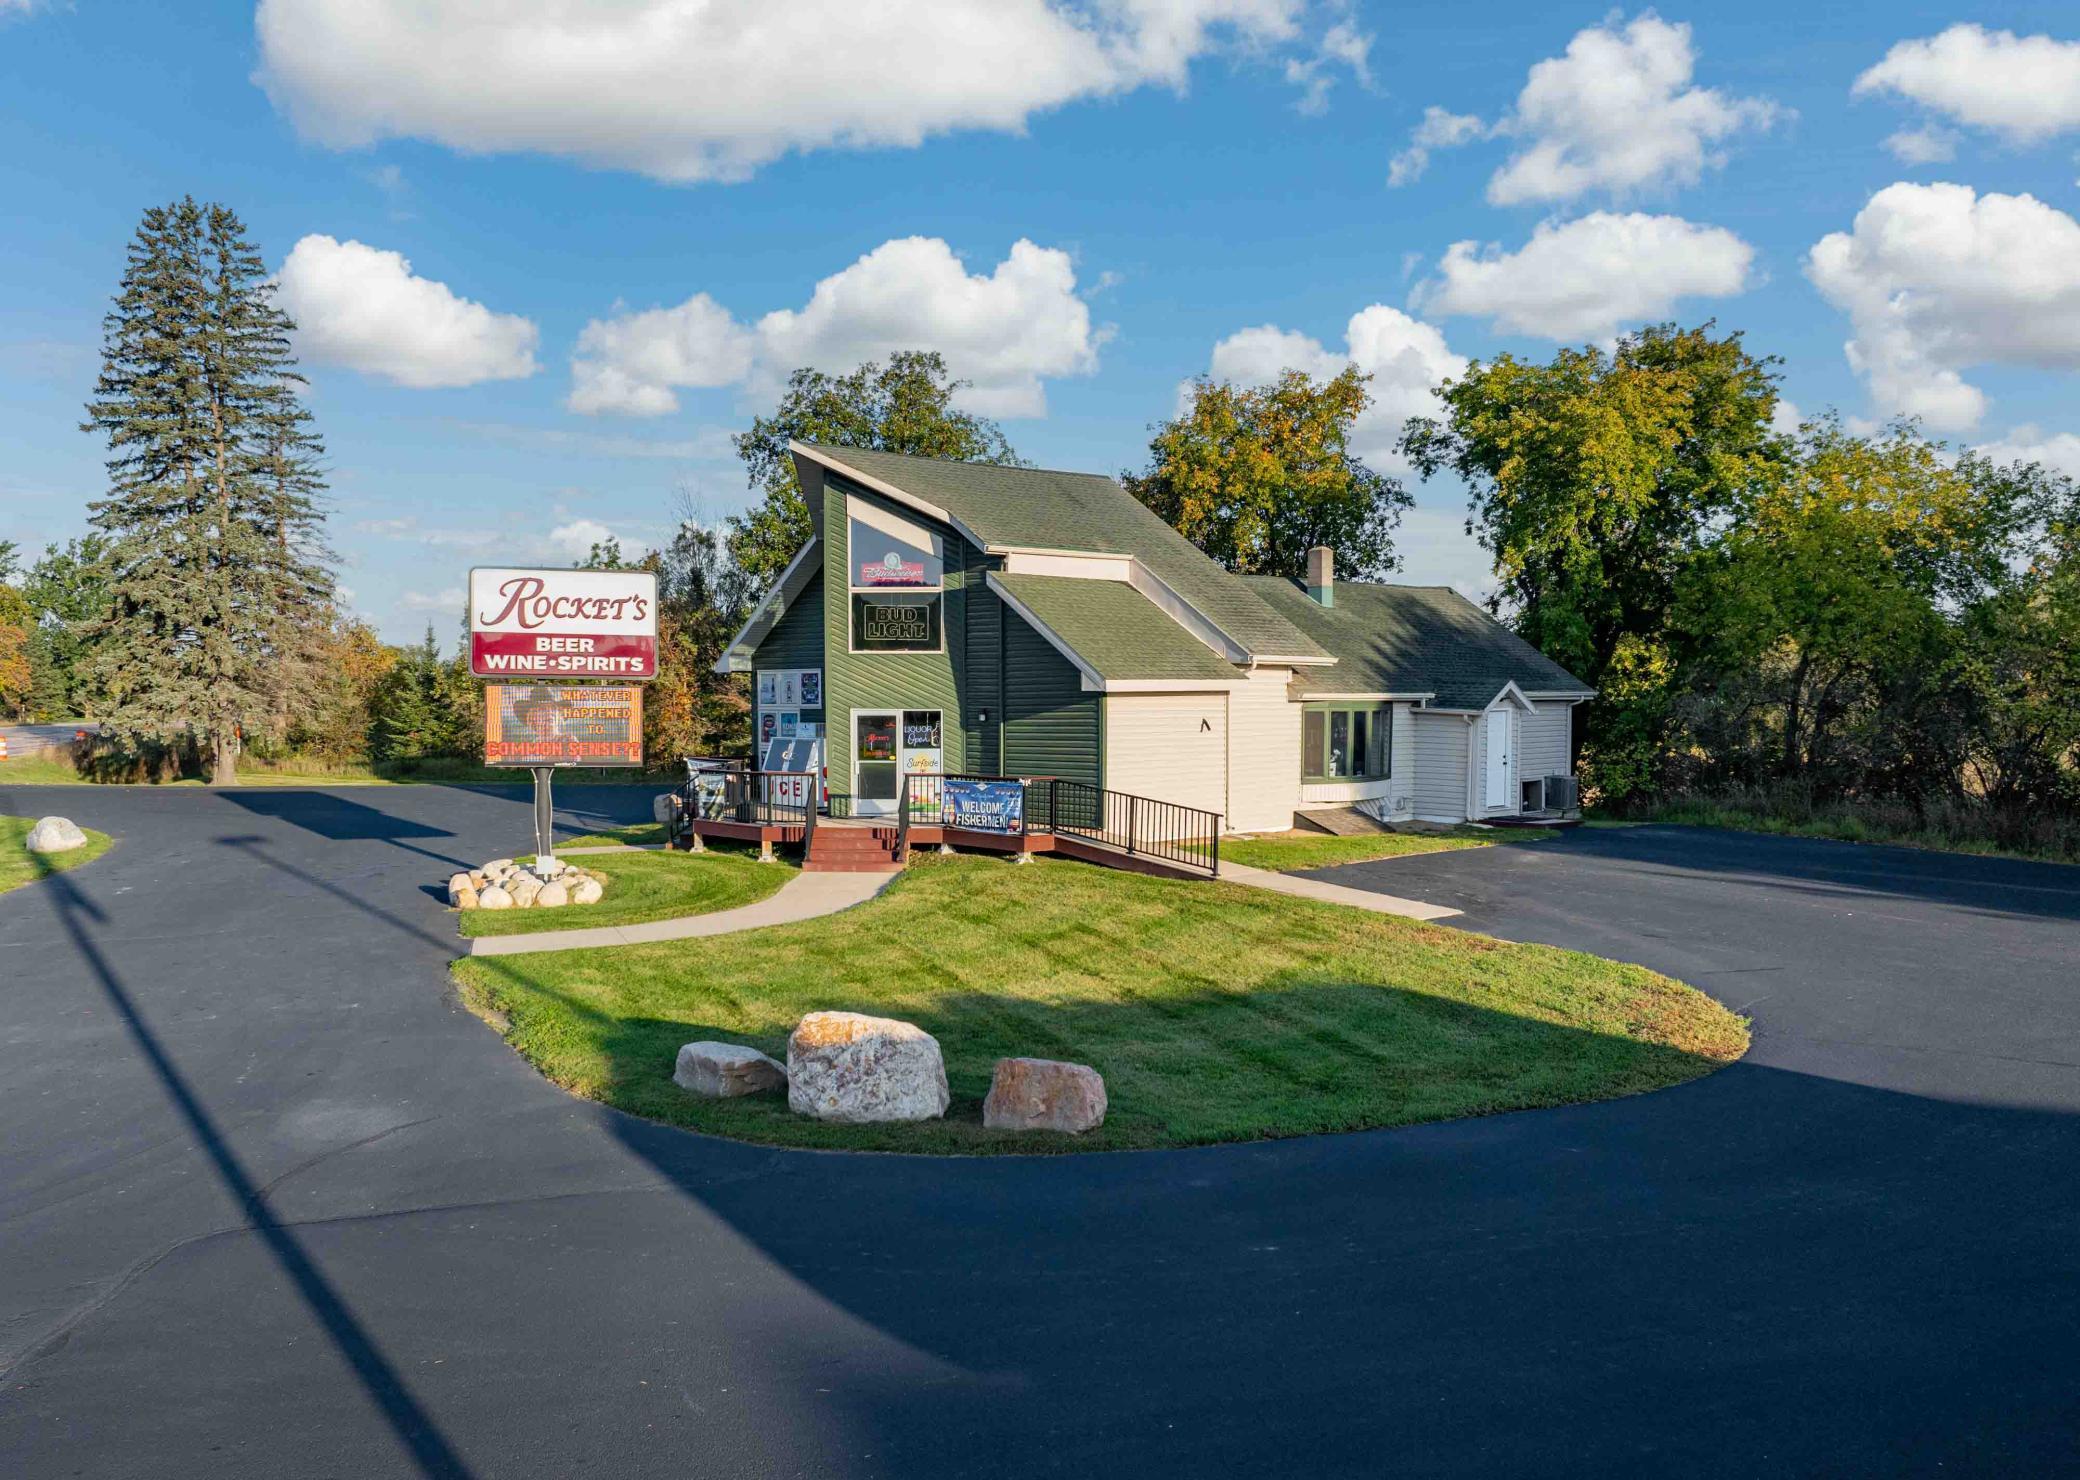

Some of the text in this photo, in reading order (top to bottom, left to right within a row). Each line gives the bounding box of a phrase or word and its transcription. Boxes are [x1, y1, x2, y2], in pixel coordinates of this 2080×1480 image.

[480, 577, 648, 629] ROCKET'S
[876, 607, 917, 622] BUD
[868, 623, 925, 638] LIGHT
[536, 637, 595, 653] BEER
[561, 690, 632, 702] WHATEVER
[563, 708, 632, 719] HAPPENED
[588, 724, 605, 735] TO
[904, 725, 932, 734] LIQUOR
[486, 741, 563, 756] COMMON
[961, 800, 1006, 814] WELCOME
[956, 814, 1009, 829] FISHERMEN!
